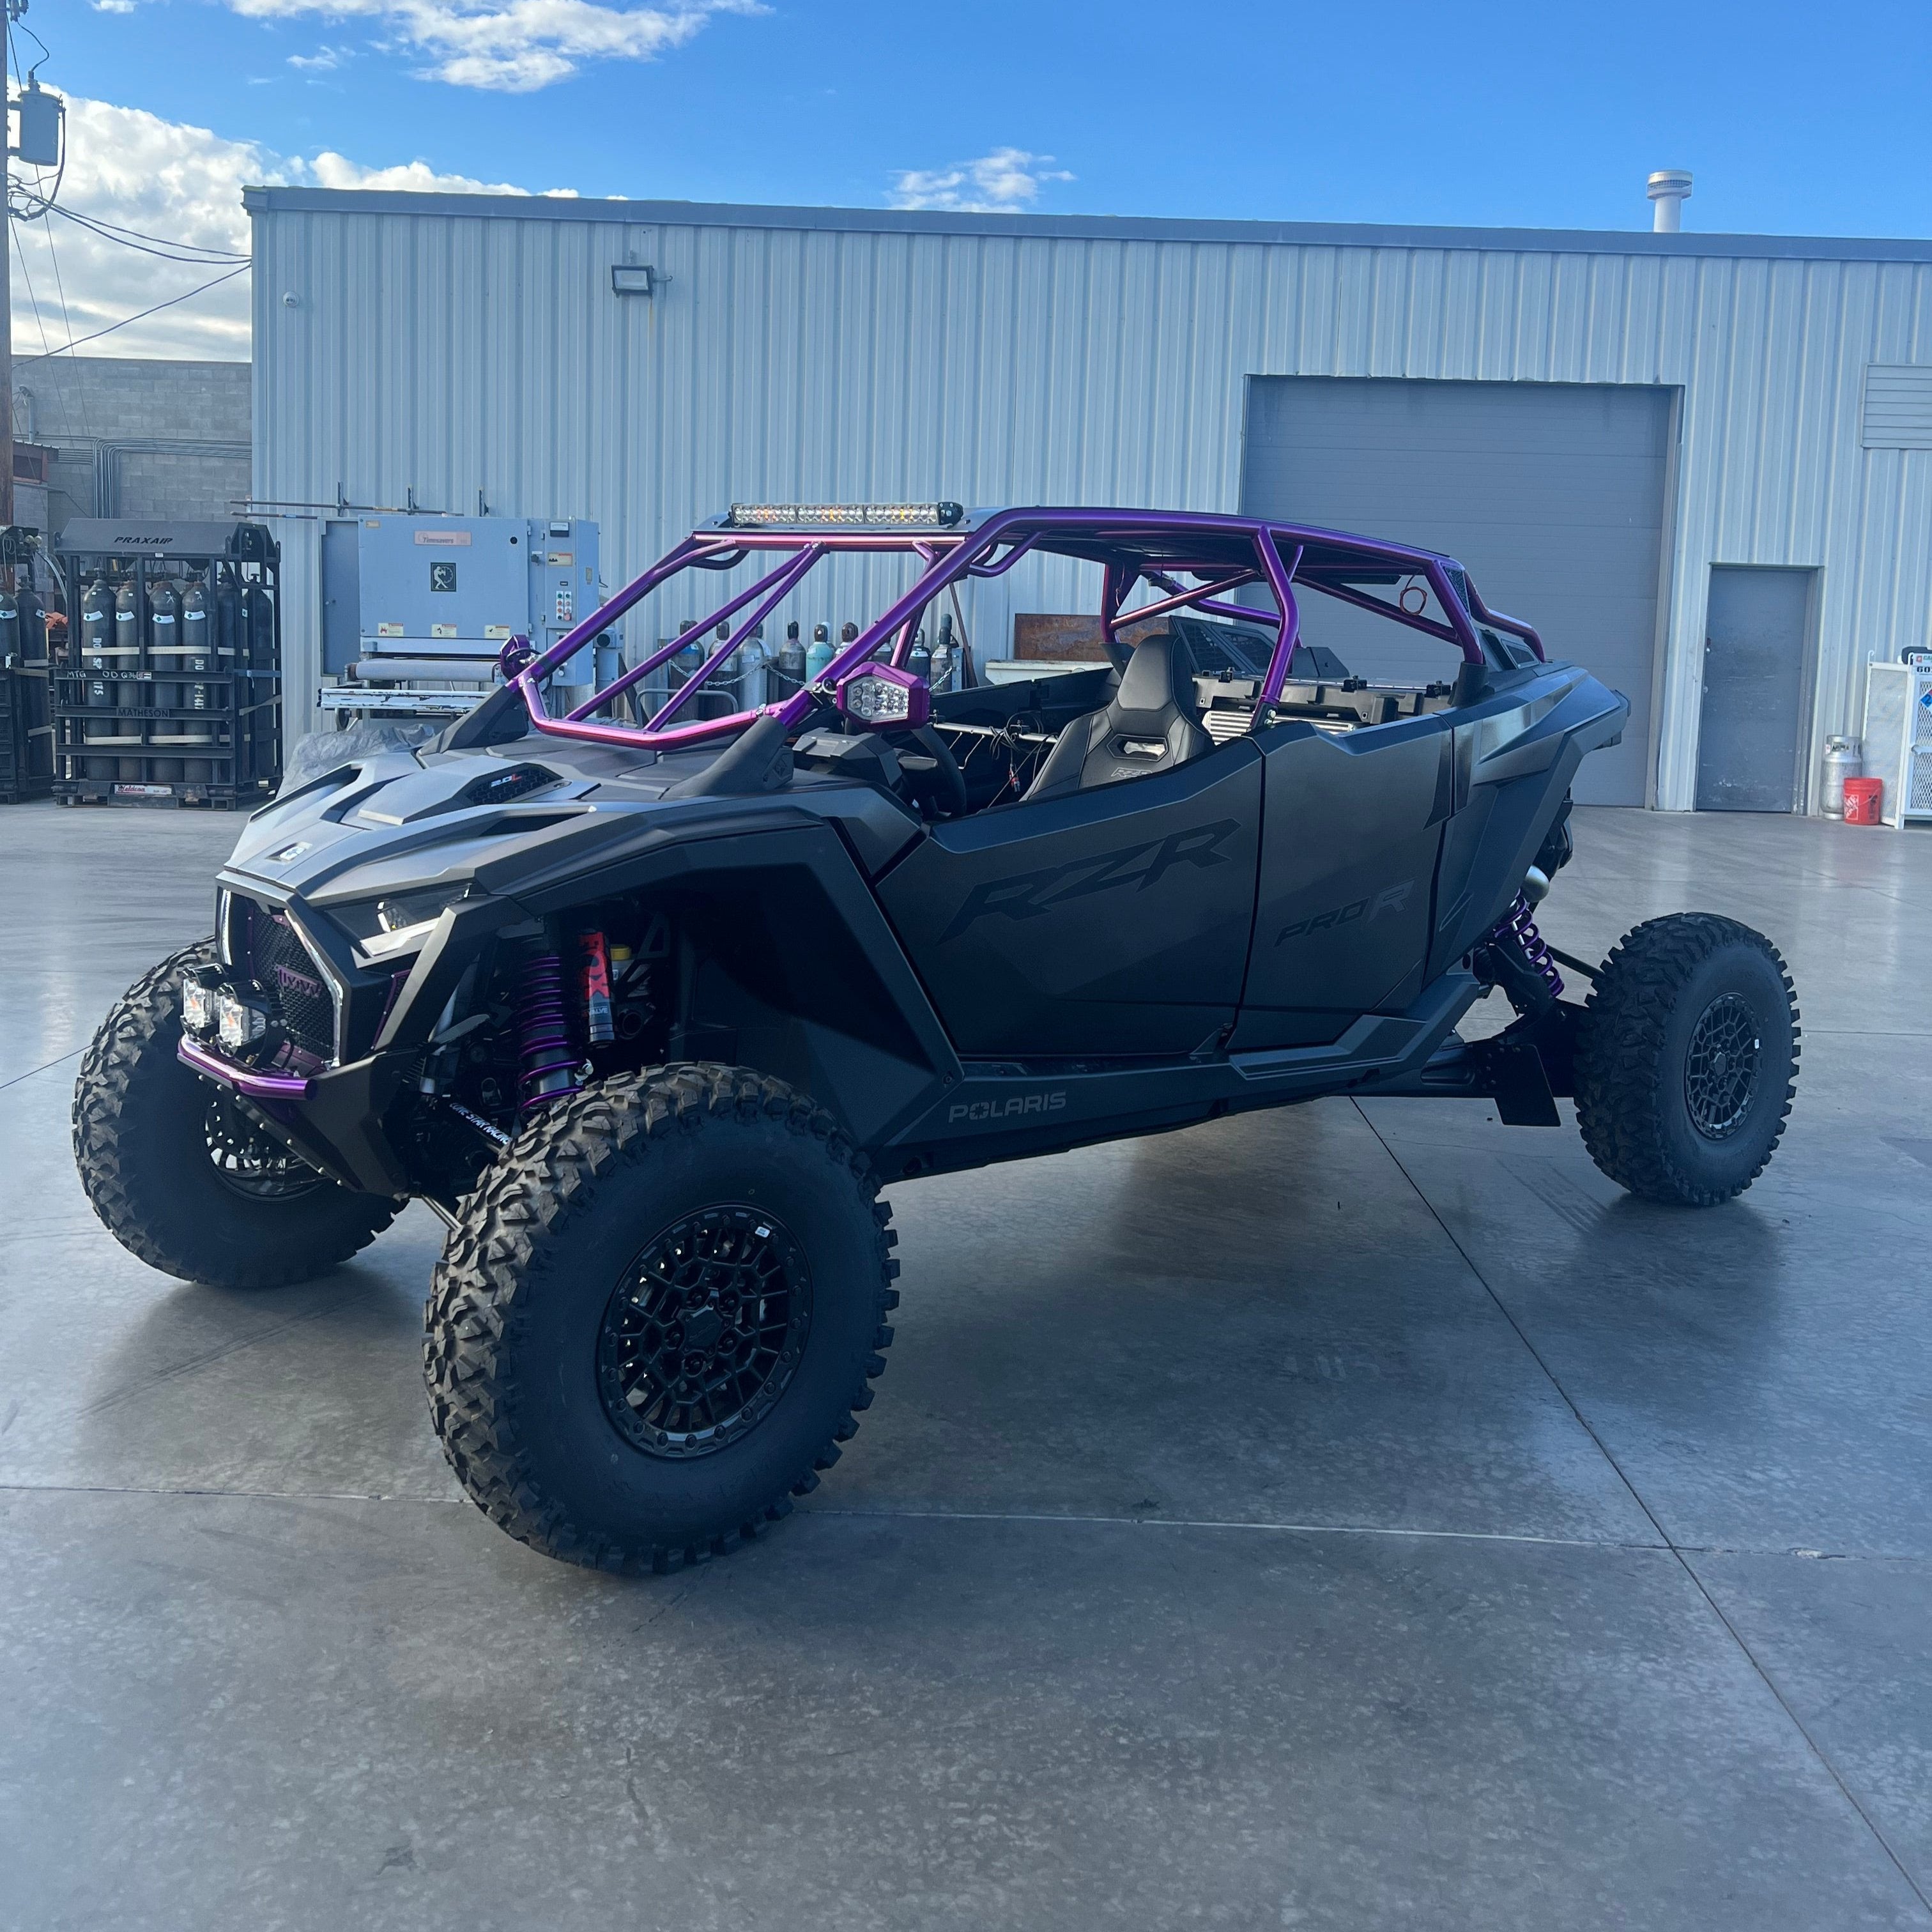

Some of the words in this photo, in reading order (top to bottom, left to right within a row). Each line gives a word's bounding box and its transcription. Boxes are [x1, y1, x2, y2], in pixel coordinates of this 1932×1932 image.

[118, 709, 169, 717] MATHESON
[935, 818, 1242, 947] RZR
[1273, 896, 1370, 947] PRO
[578, 932, 611, 1000] FOX
[466, 1114, 491, 1128] STAR
[948, 1091, 1066, 1123] POLARIS
